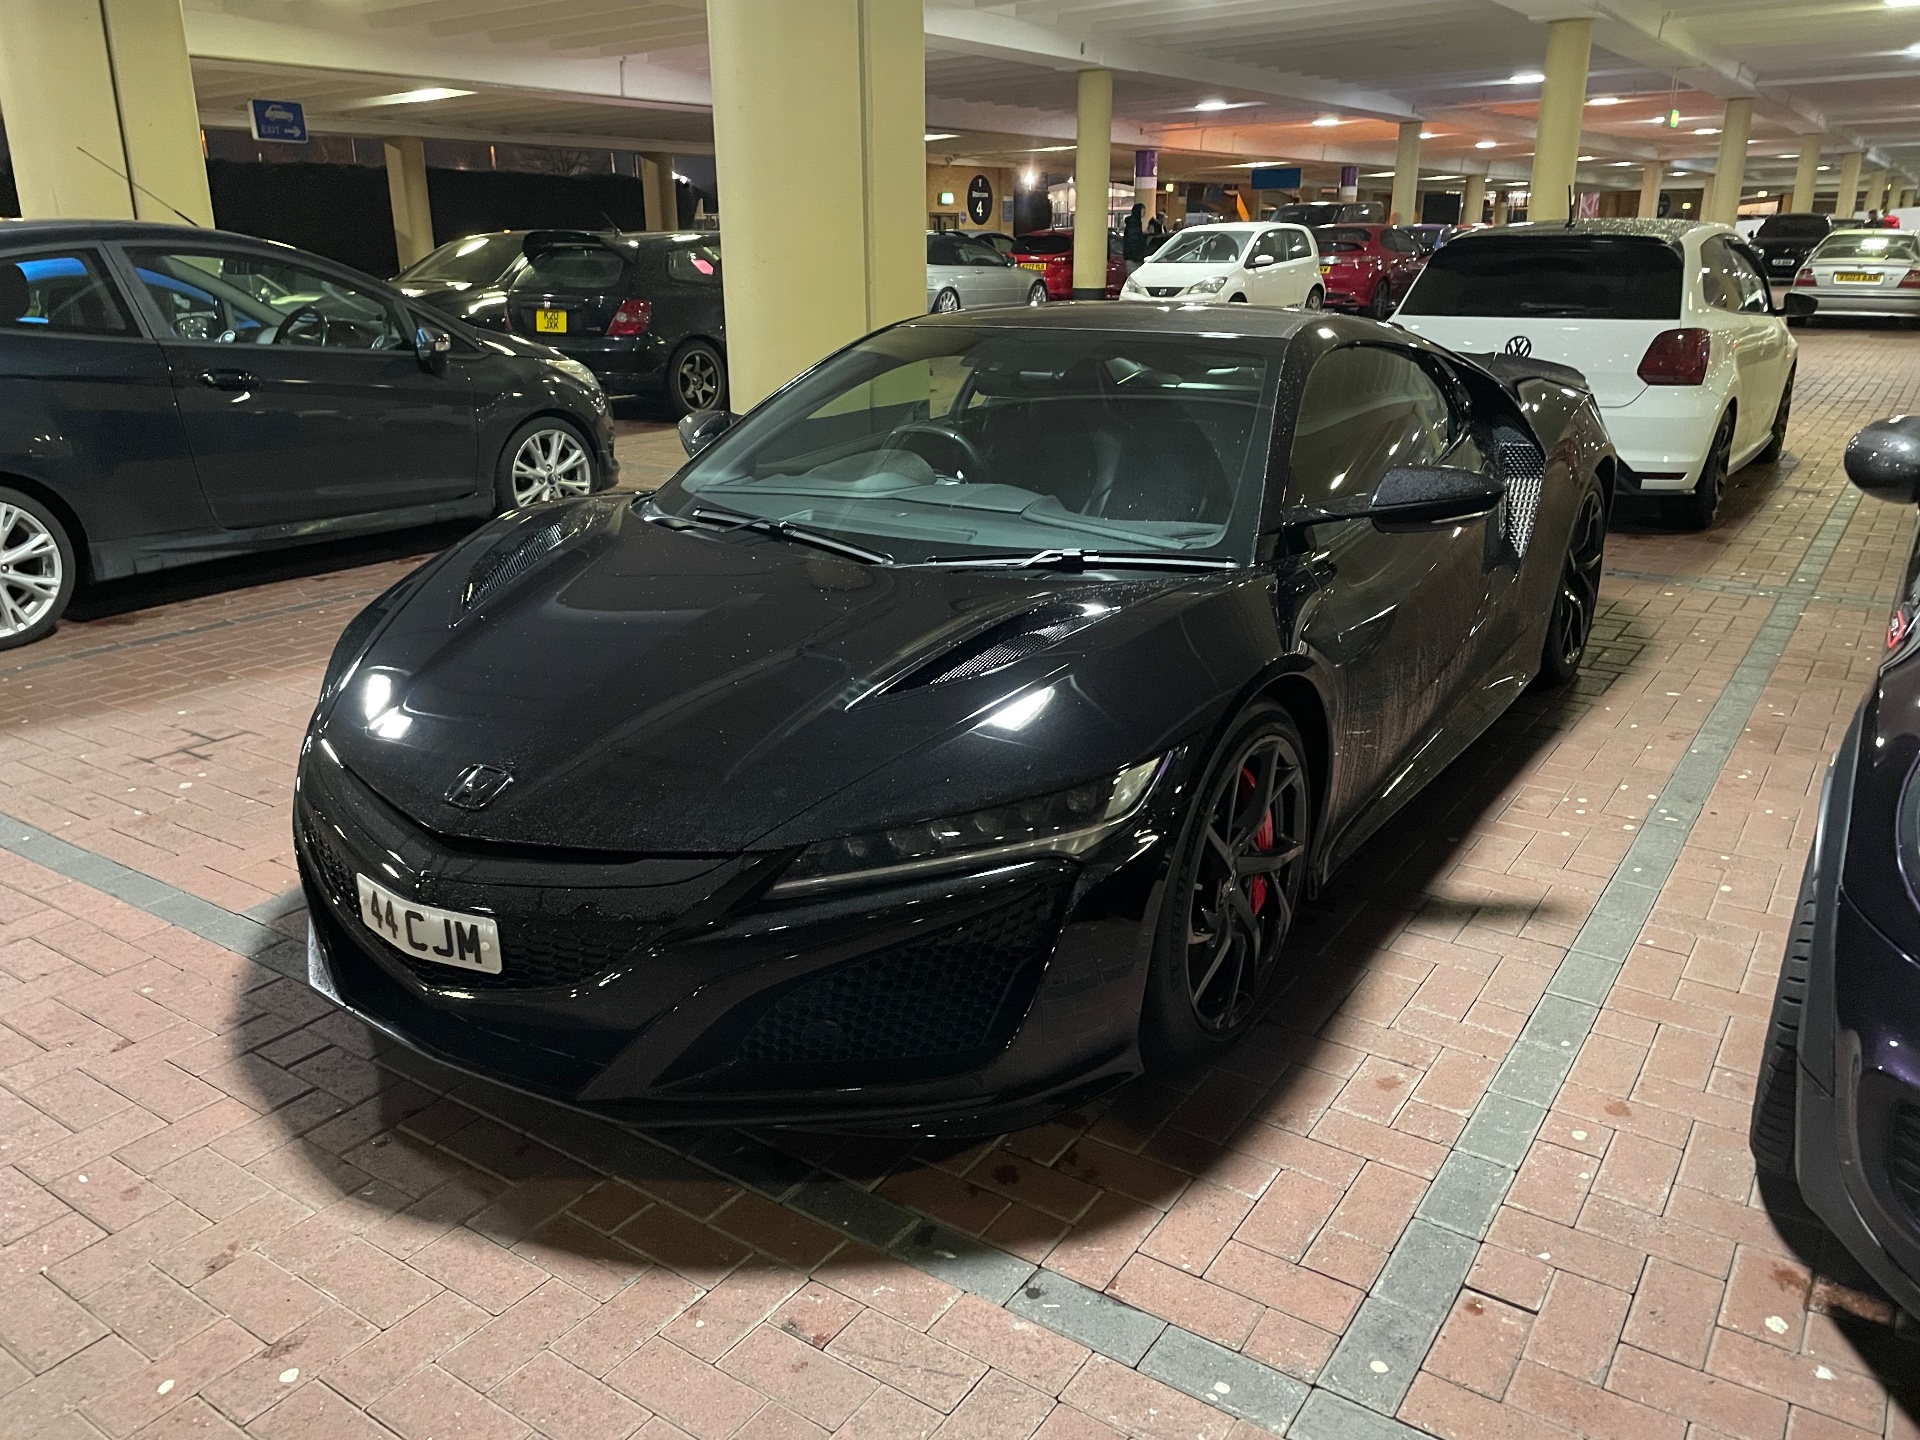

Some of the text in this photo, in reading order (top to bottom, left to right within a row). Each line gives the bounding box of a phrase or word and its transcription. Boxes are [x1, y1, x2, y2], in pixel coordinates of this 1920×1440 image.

[261, 125, 280, 134] EXIT
[976, 200, 984, 217] 4
[544, 311, 559, 320] K20
[545, 320, 559, 329] JXK
